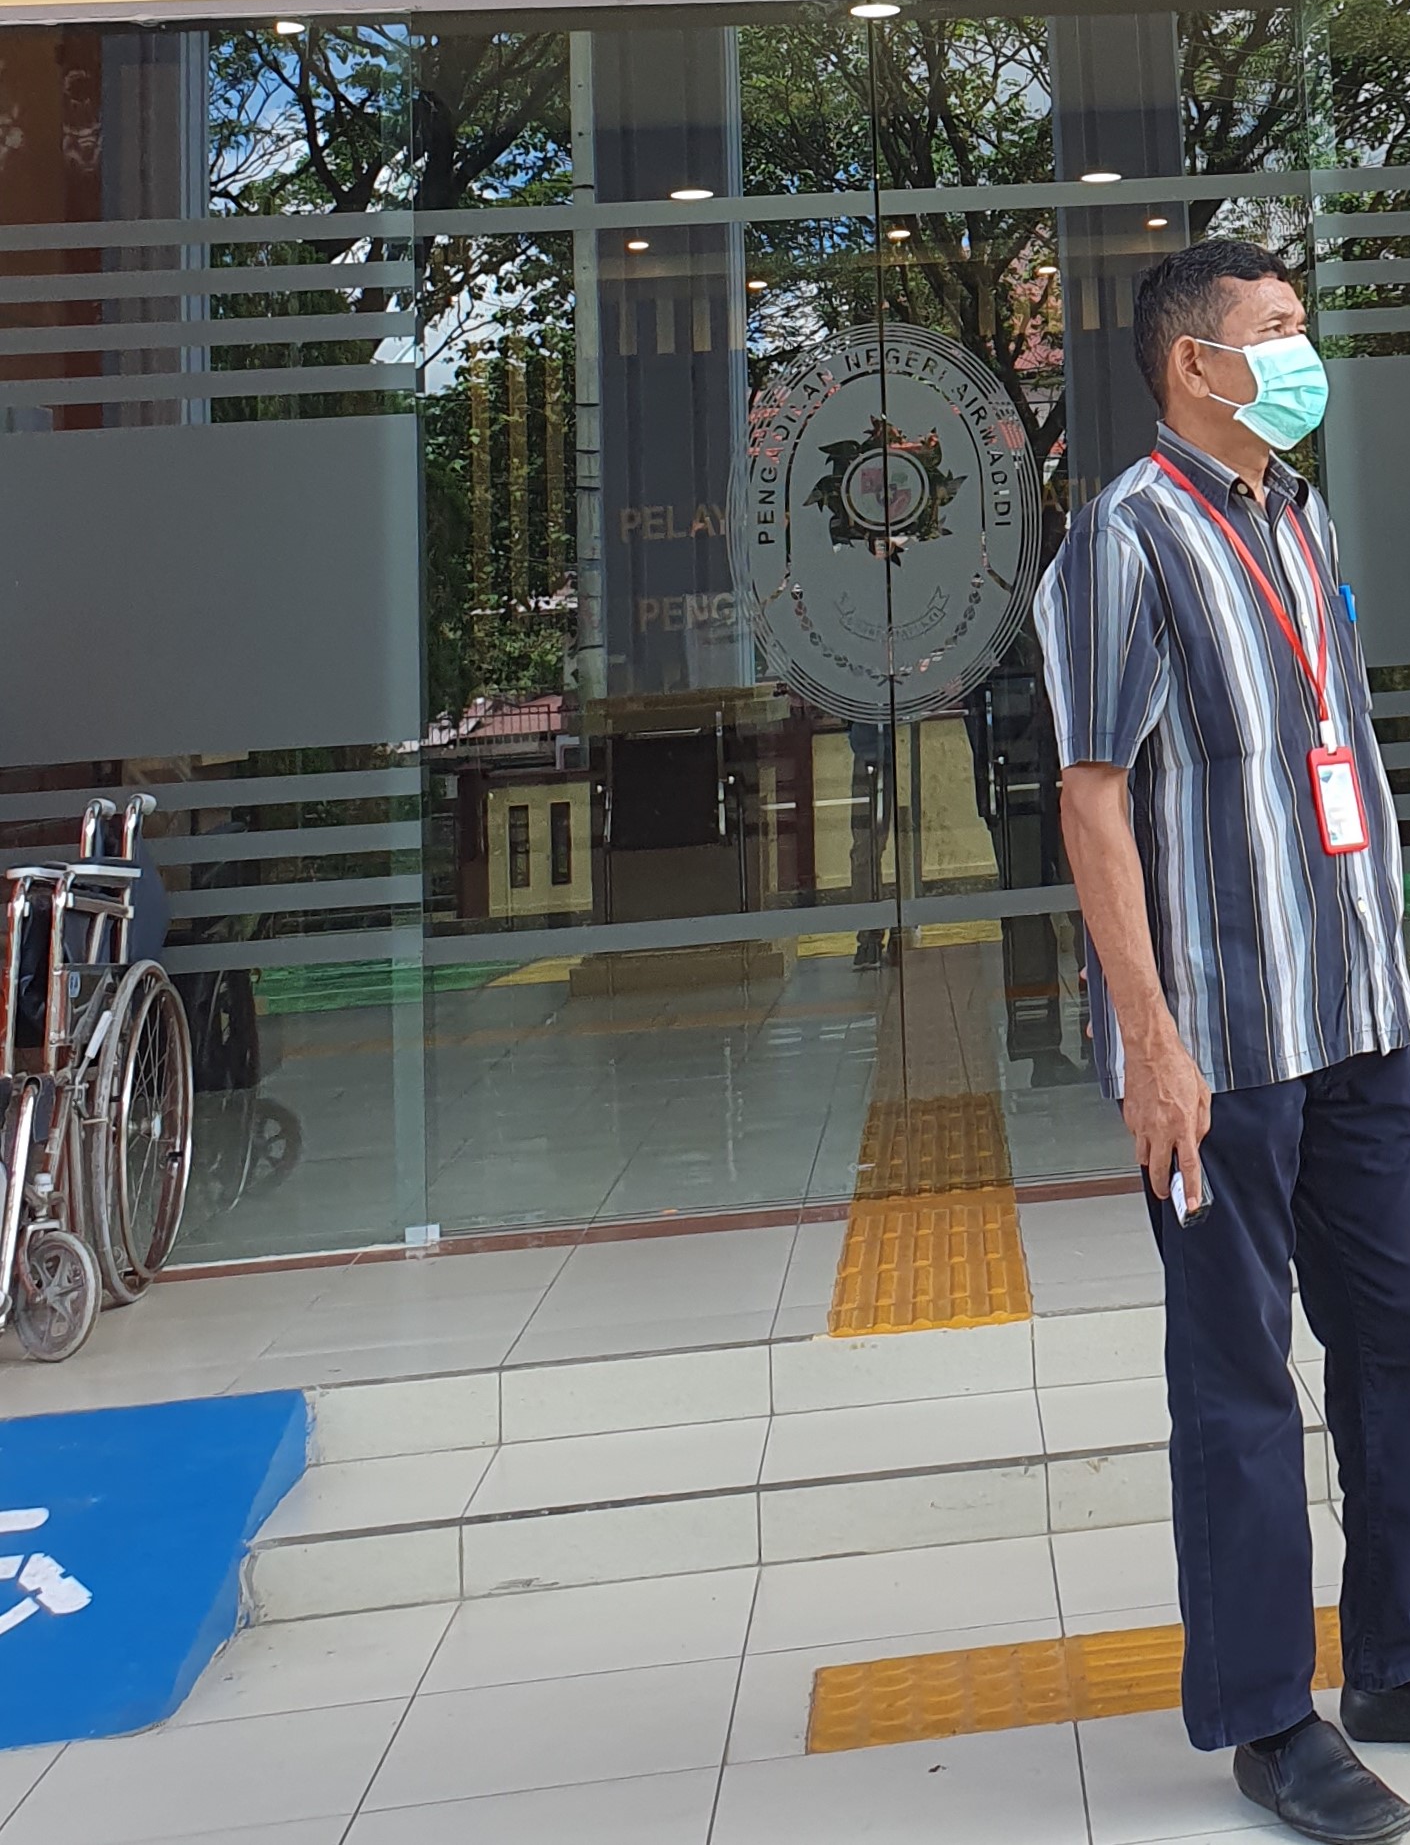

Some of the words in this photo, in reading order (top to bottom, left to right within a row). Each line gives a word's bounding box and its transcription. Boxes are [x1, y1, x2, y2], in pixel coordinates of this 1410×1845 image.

[757, 368, 836, 545] PENGADILAN
[844, 347, 950, 382] NEGERI
[951, 383, 1012, 527] AIRMADIDI
